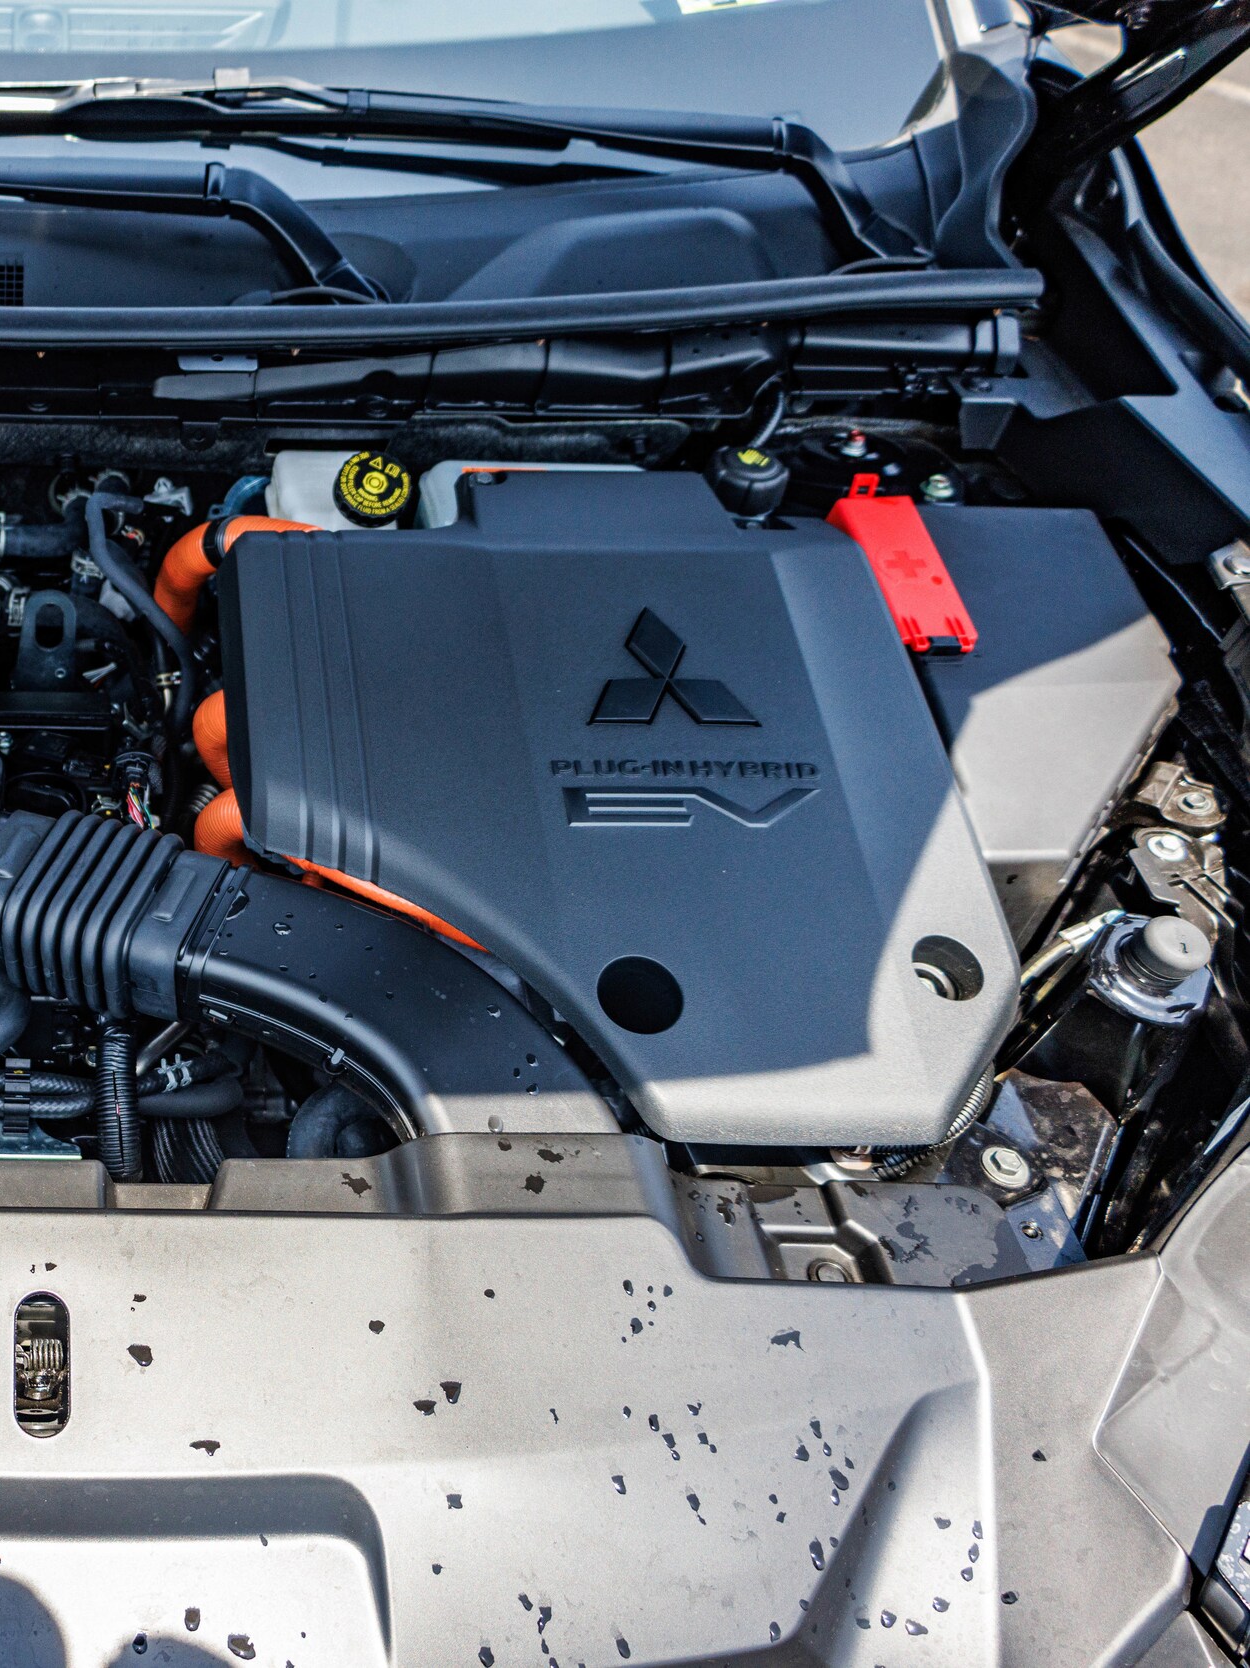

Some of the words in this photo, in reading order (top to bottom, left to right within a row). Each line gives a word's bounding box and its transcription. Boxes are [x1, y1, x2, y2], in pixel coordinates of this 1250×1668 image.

[357, 504, 371, 514] FLUID
[371, 507, 386, 515] FROM
[362, 499, 382, 508] BEFORE
[551, 759, 685, 778] PLUG-IN
[690, 760, 820, 780] HYBRID
[562, 786, 821, 828] EV
